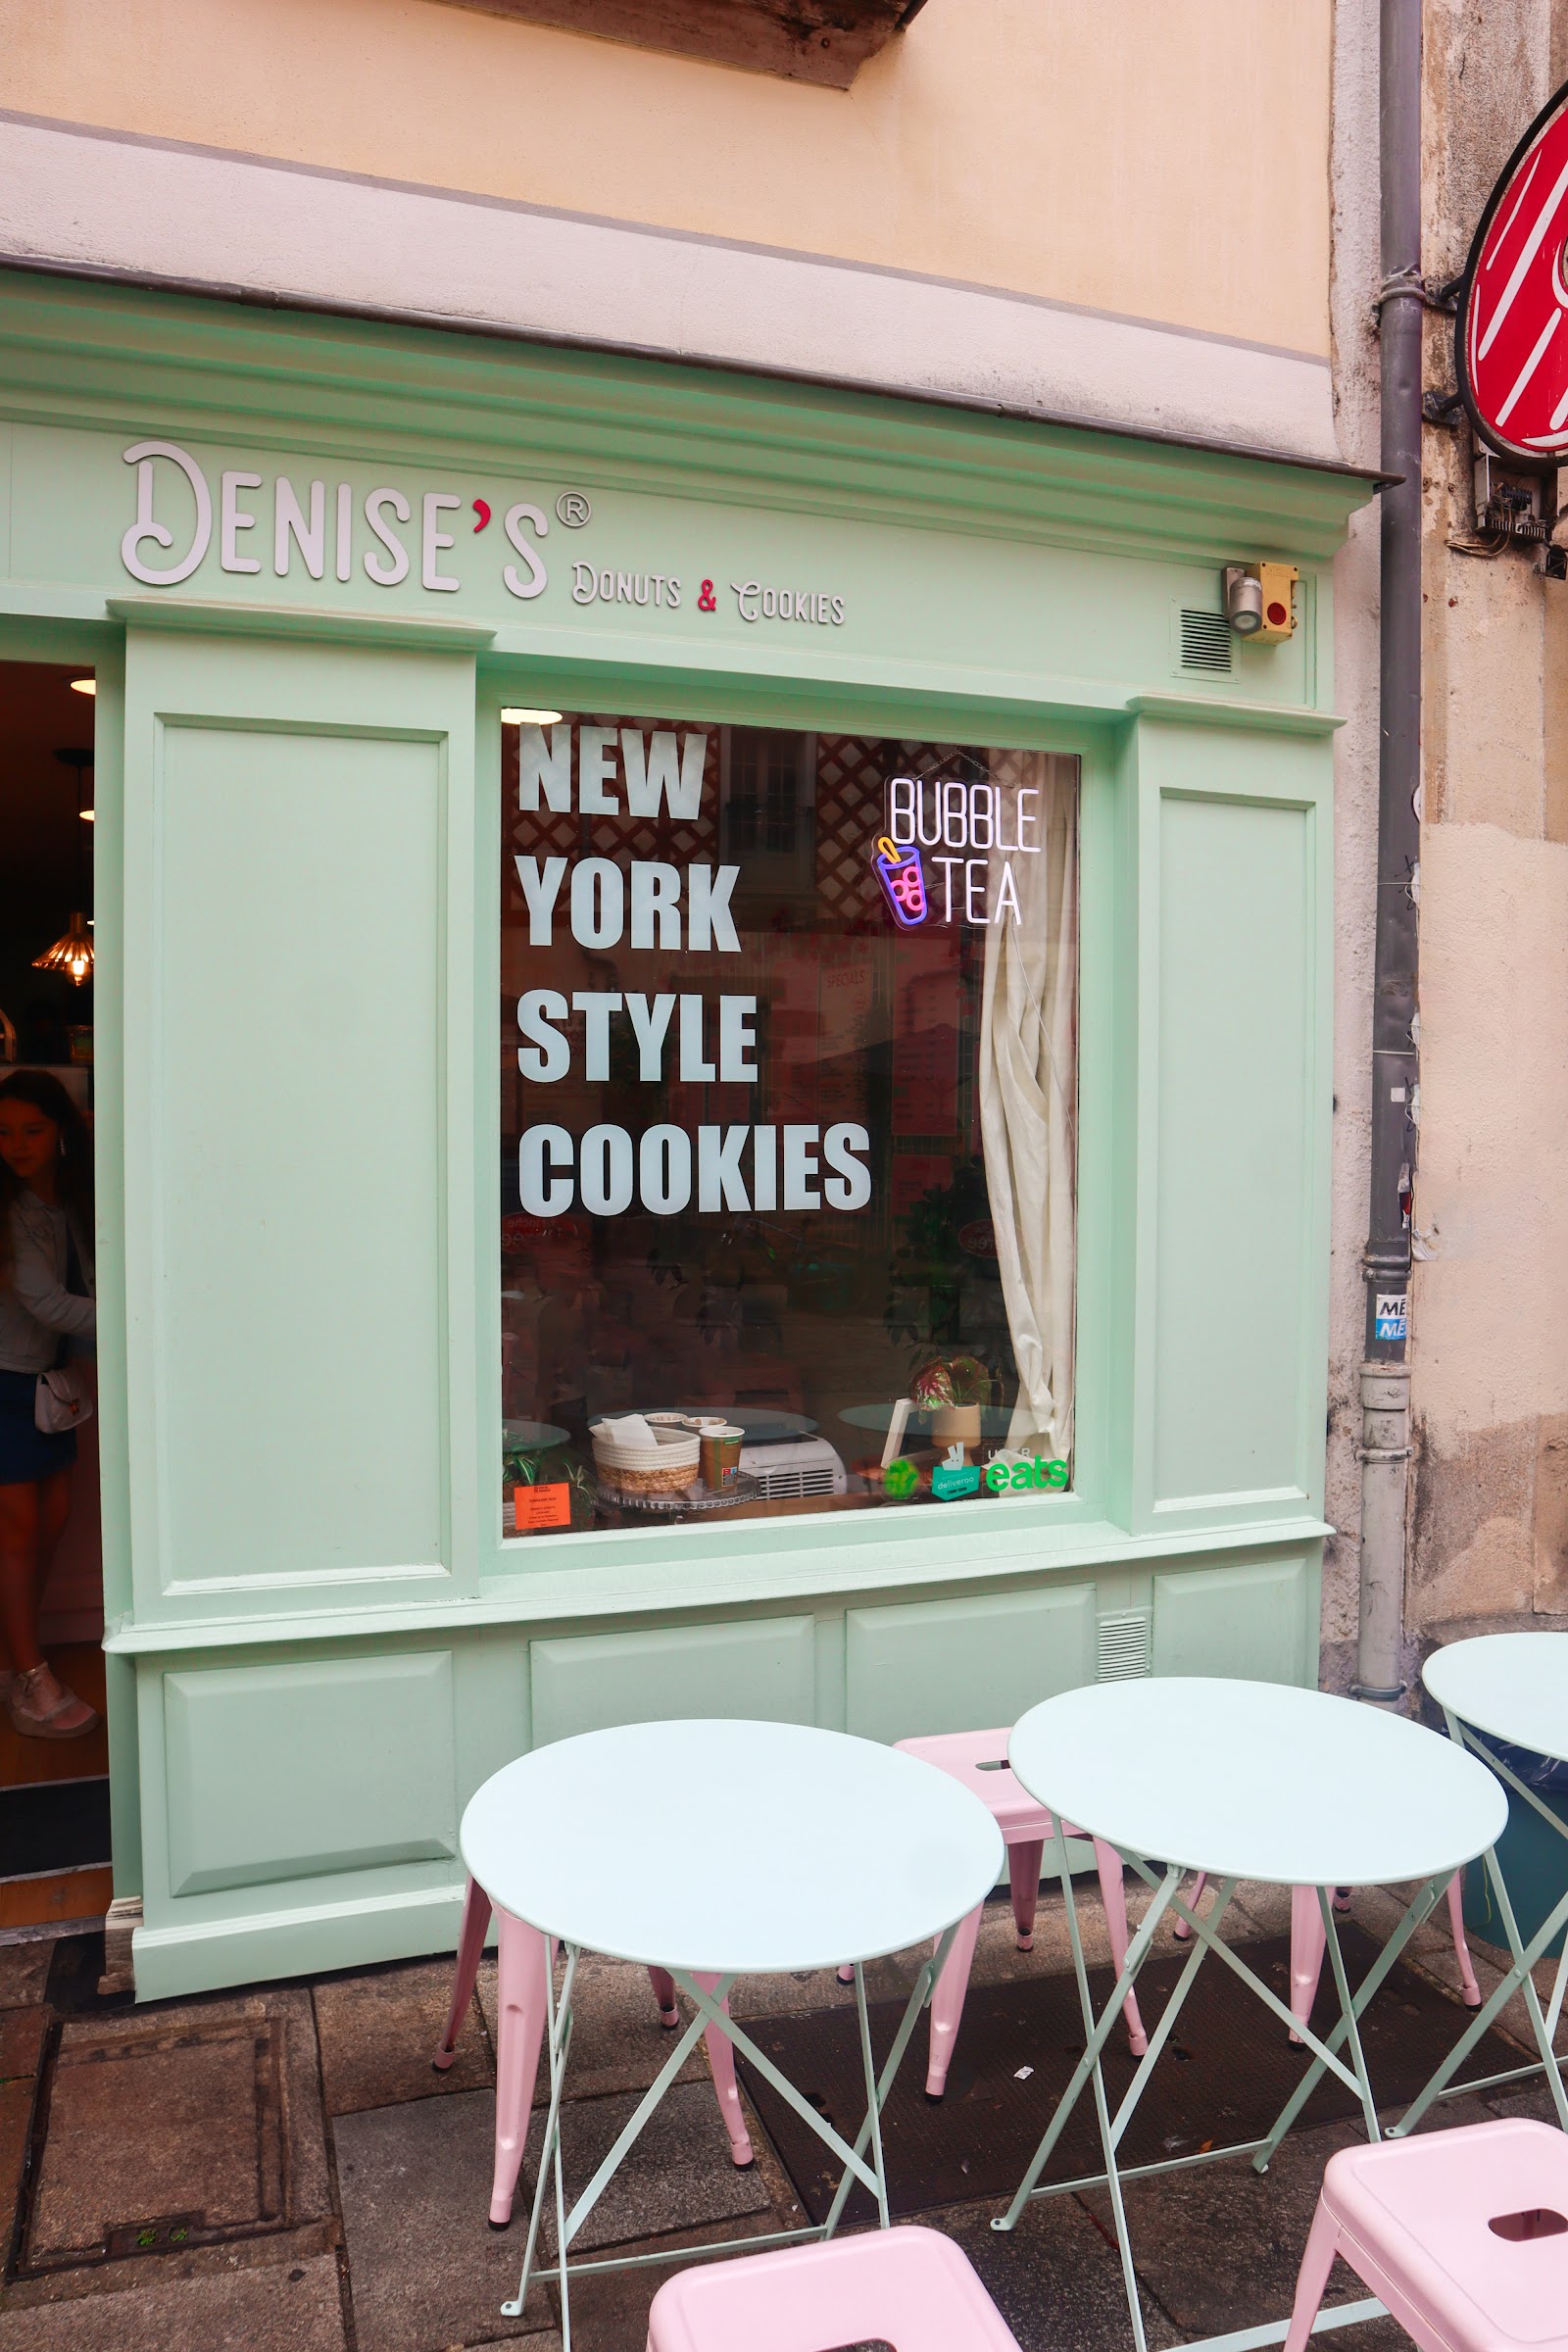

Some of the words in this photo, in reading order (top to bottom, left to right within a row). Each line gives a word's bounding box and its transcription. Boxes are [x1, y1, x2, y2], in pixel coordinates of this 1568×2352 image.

[572, 560, 682, 609] DONUTS
[697, 578, 717, 612] &
[730, 580, 846, 625] COOKIES
[517, 721, 708, 821] NEW
[890, 777, 1042, 853] BUBBLE
[513, 855, 743, 954] YORK
[931, 856, 1022, 926] TEA
[515, 988, 759, 1084] STYLE
[517, 1121, 873, 1218] COOKIES
[937, 1476, 975, 1491] deliveroo
[985, 1453, 1069, 1493] eats
